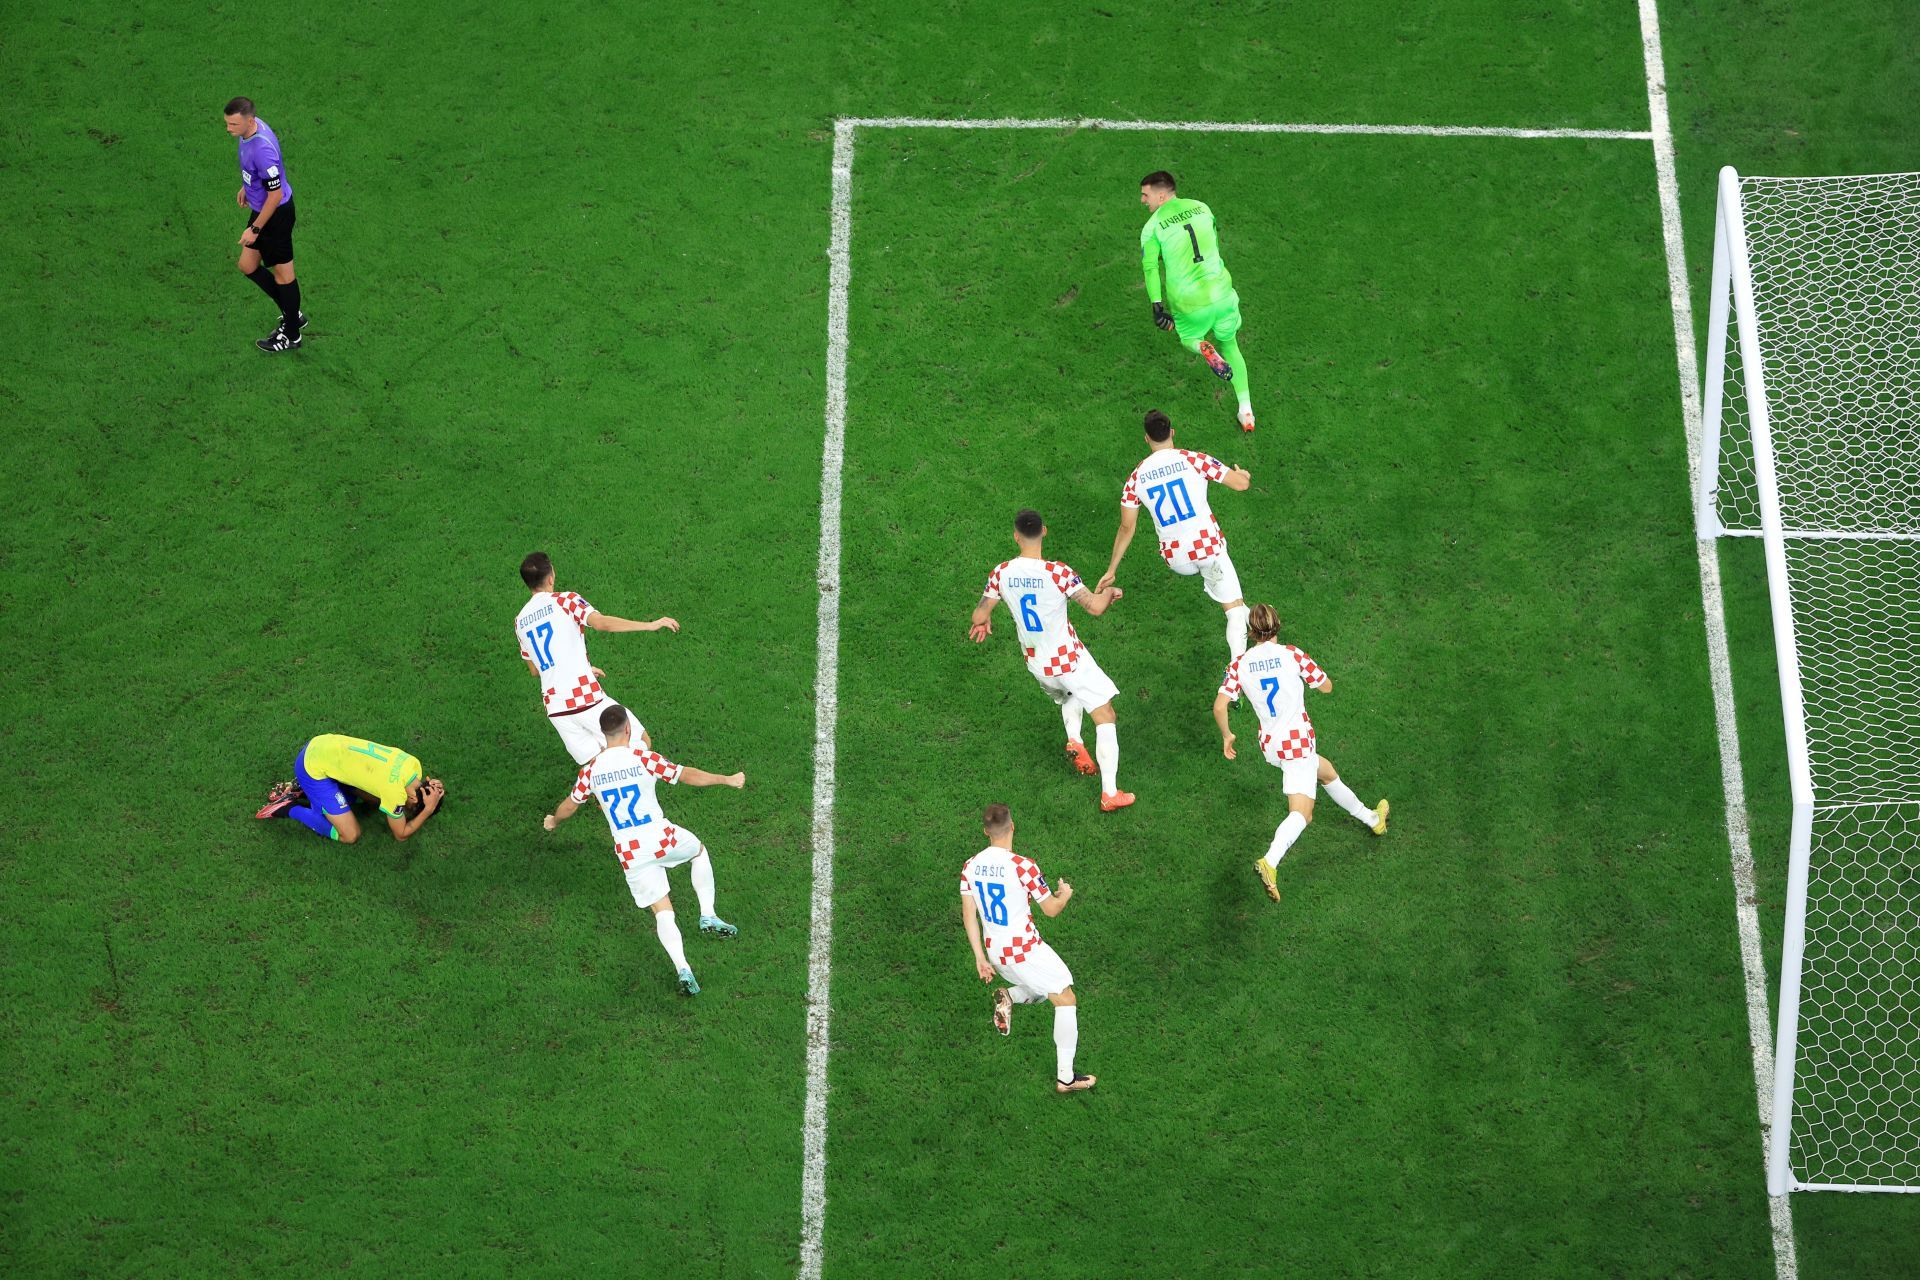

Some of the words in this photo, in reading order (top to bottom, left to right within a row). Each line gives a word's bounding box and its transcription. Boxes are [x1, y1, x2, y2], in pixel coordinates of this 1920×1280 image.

[1183, 223, 1204, 264] 1
[1146, 477, 1196, 527] 20
[1008, 577, 1044, 589] LOVREN
[1020, 593, 1044, 632] 6
[526, 621, 555, 672] 17
[1248, 657, 1282, 673] MAJER
[1260, 677, 1280, 717] 7
[348, 742, 393, 763] 4
[601, 783, 652, 831] 22
[974, 880, 1008, 927] 18
